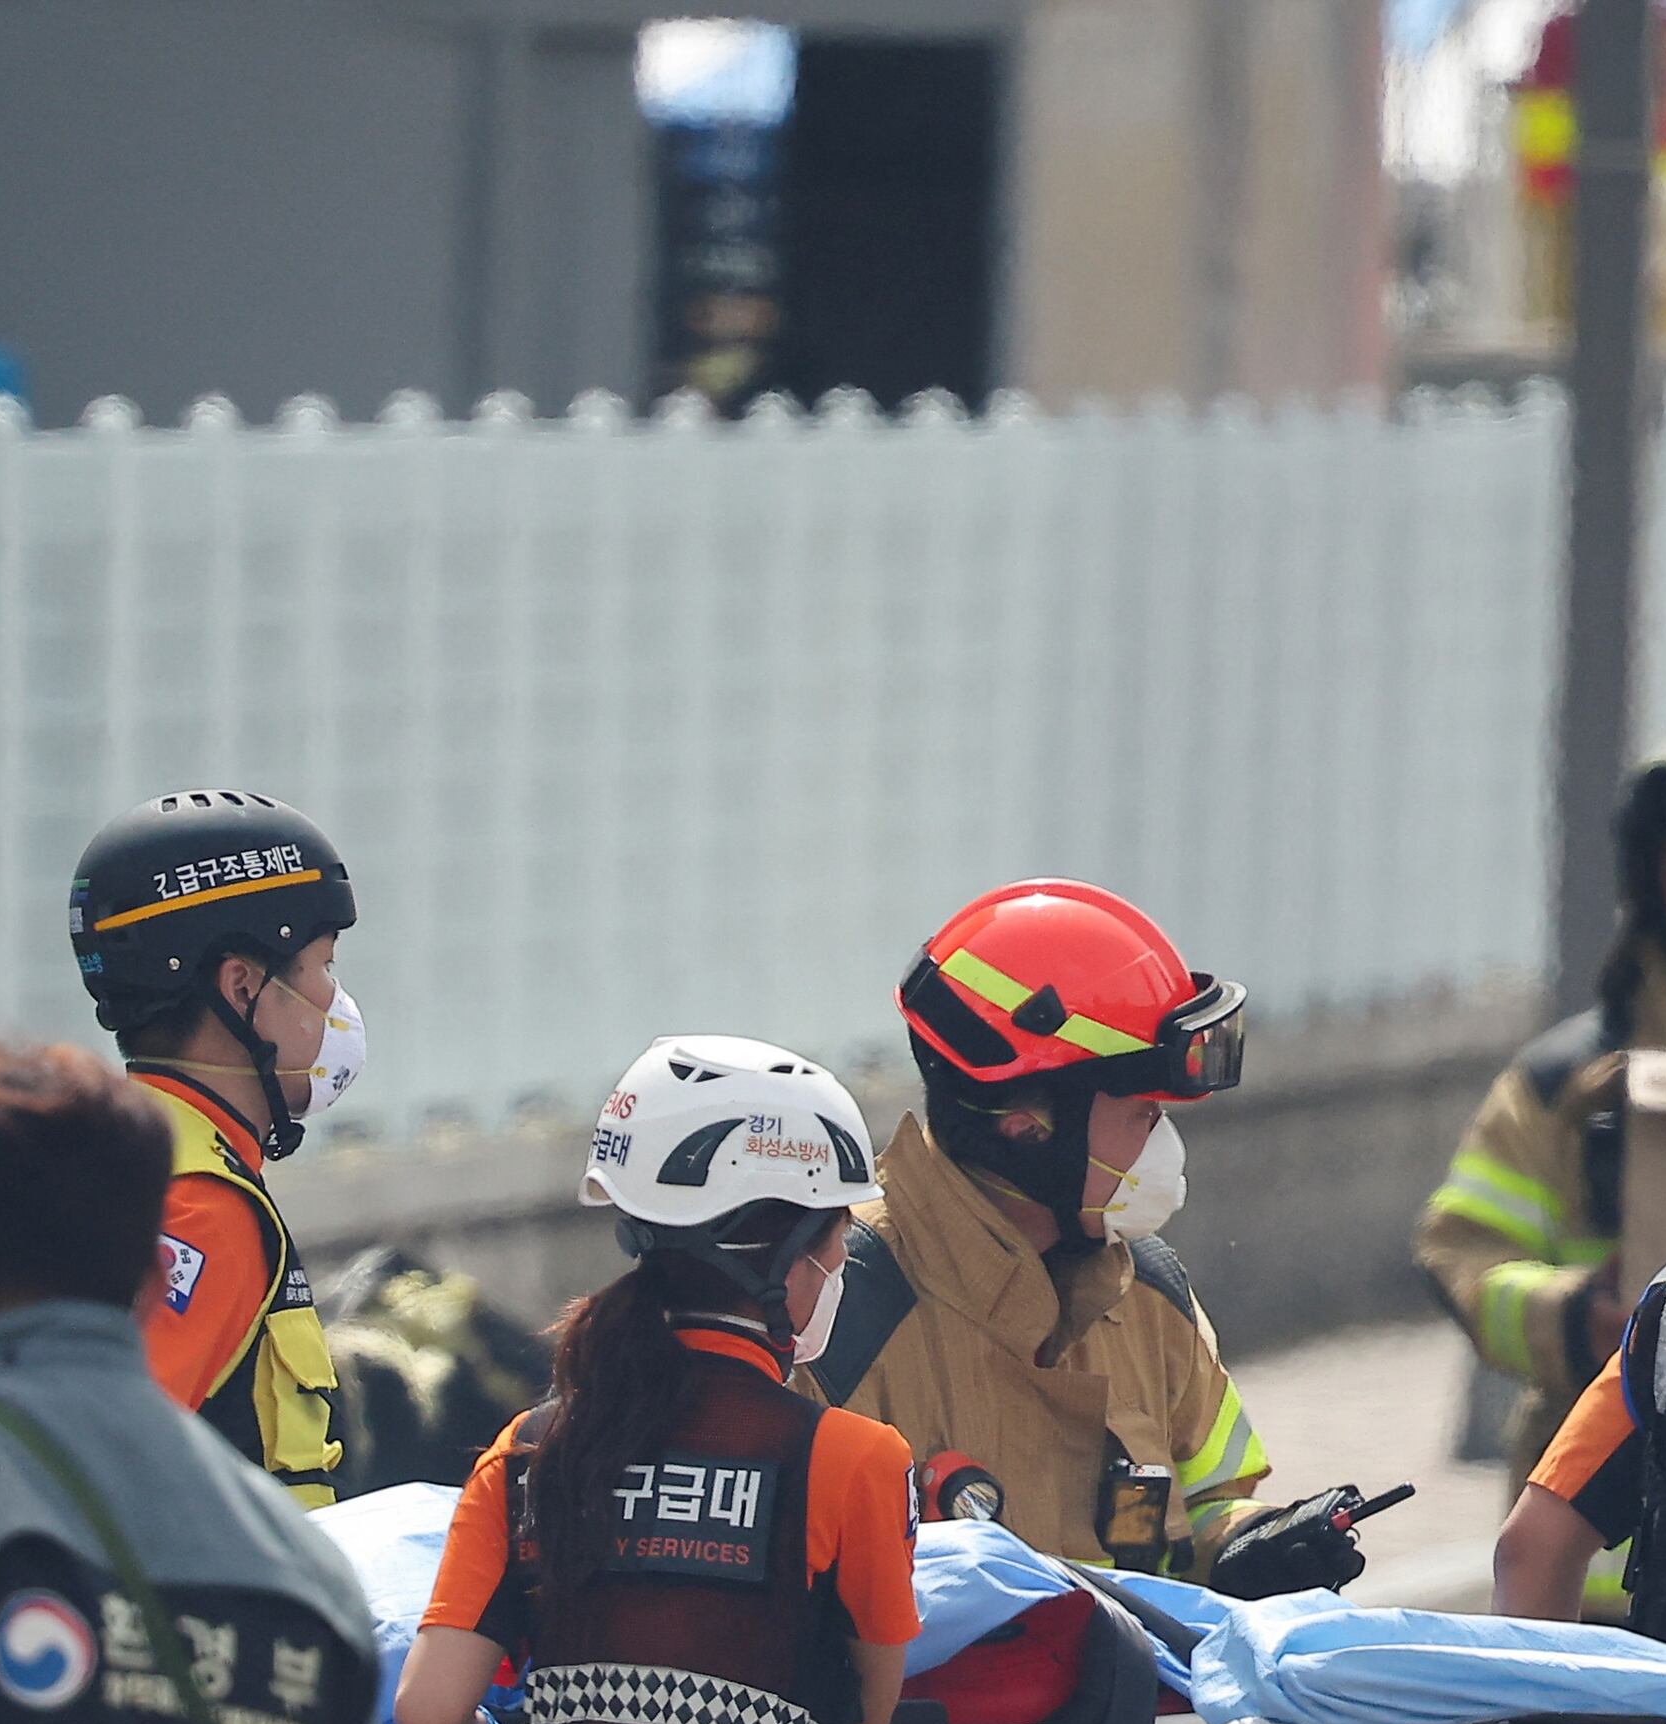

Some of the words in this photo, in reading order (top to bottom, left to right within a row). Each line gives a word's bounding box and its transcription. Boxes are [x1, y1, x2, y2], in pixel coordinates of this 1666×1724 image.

[153, 844, 303, 900] 긴급구조통제단
[748, 1115, 782, 1135] 경기
[745, 1136, 829, 1163] 화성소방서
[612, 1463, 761, 1528] 구급대
[636, 1537, 750, 1565] SERVICES
